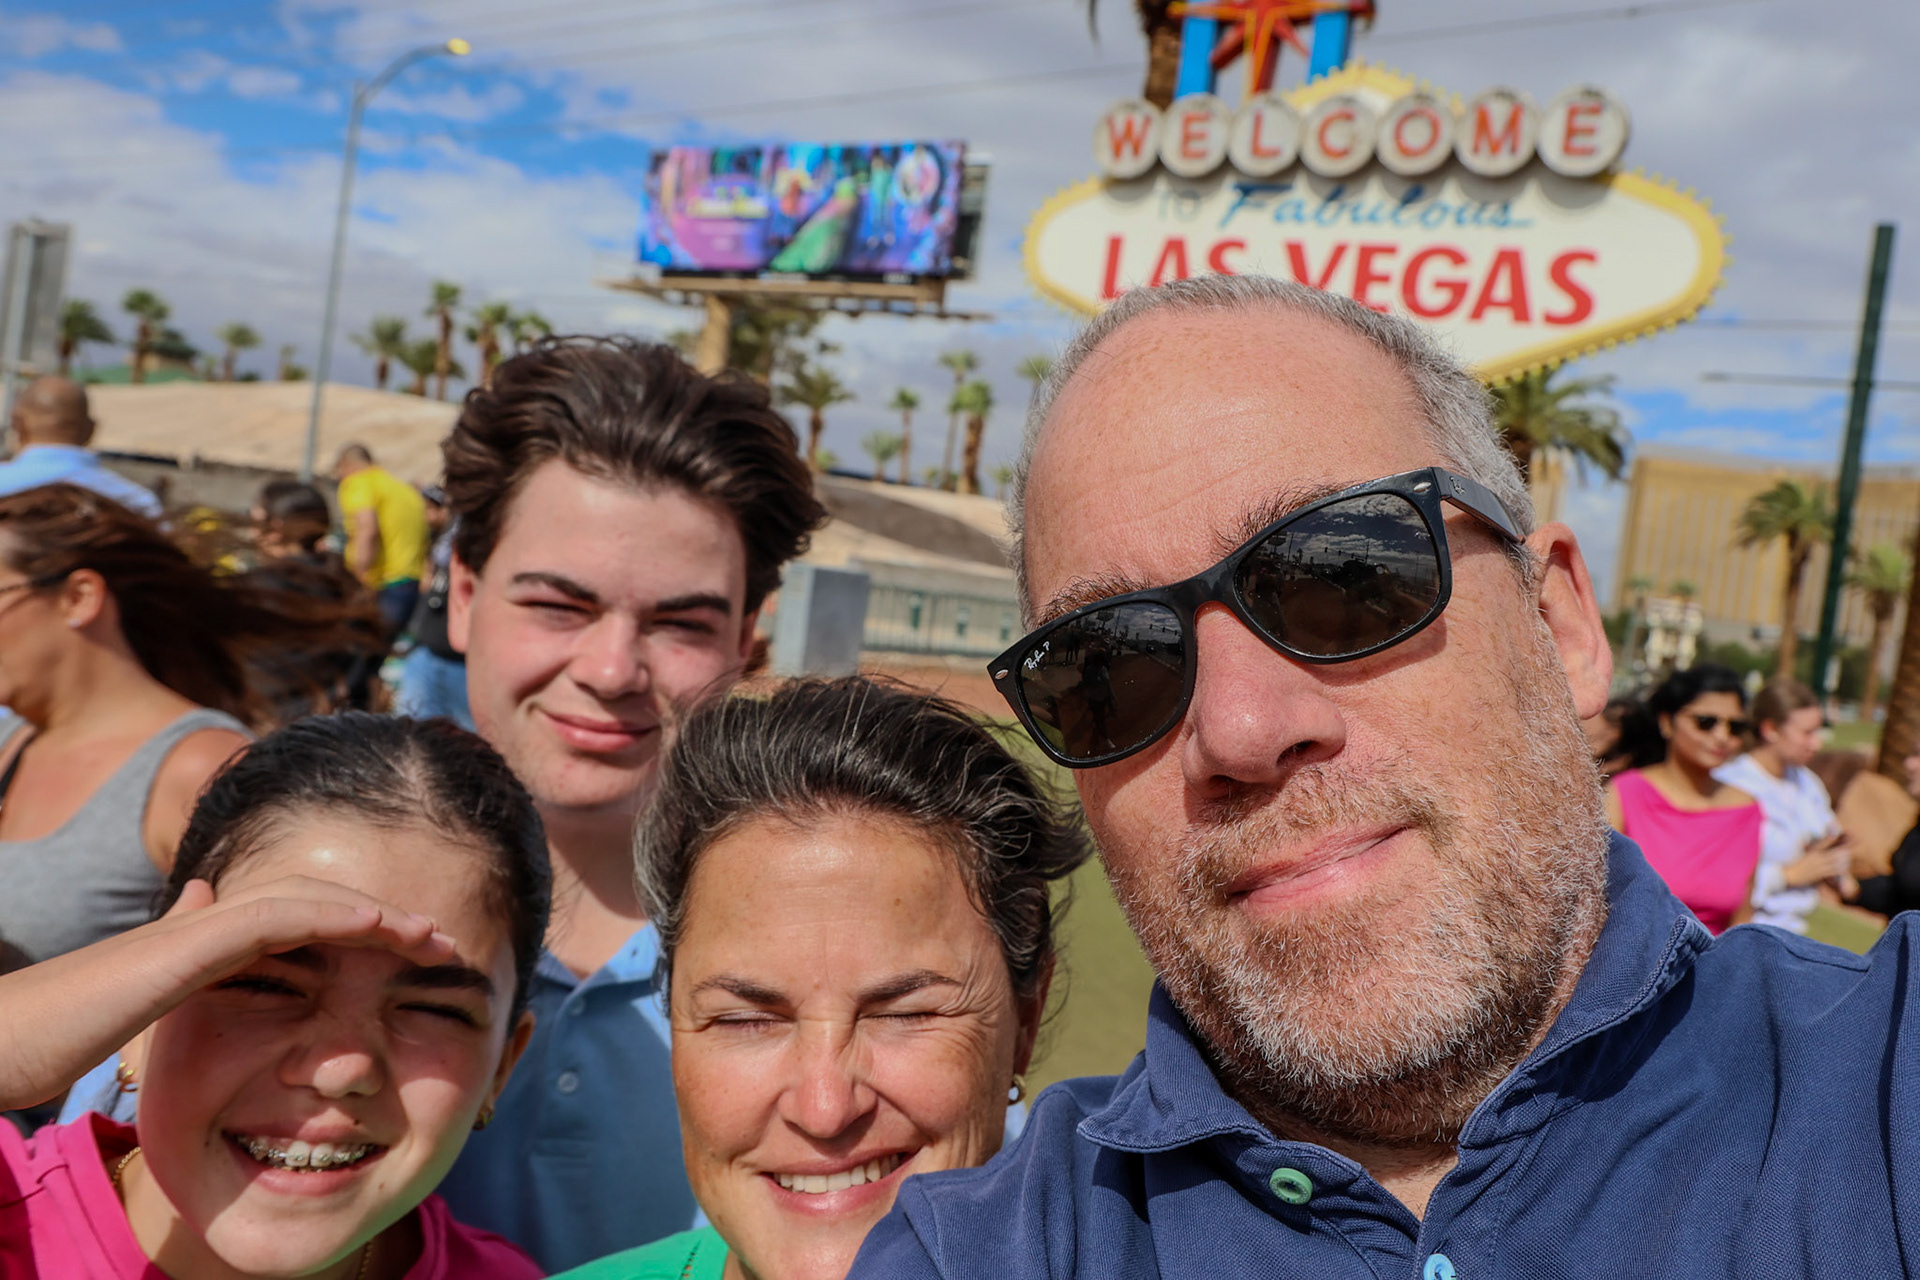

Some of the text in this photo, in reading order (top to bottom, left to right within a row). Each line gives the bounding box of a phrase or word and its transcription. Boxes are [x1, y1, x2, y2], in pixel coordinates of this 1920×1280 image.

[1106, 101, 1604, 164] WELCOME
[1217, 182, 1533, 230] Fabulous
[1101, 236, 1598, 326] LAS VEGAS
